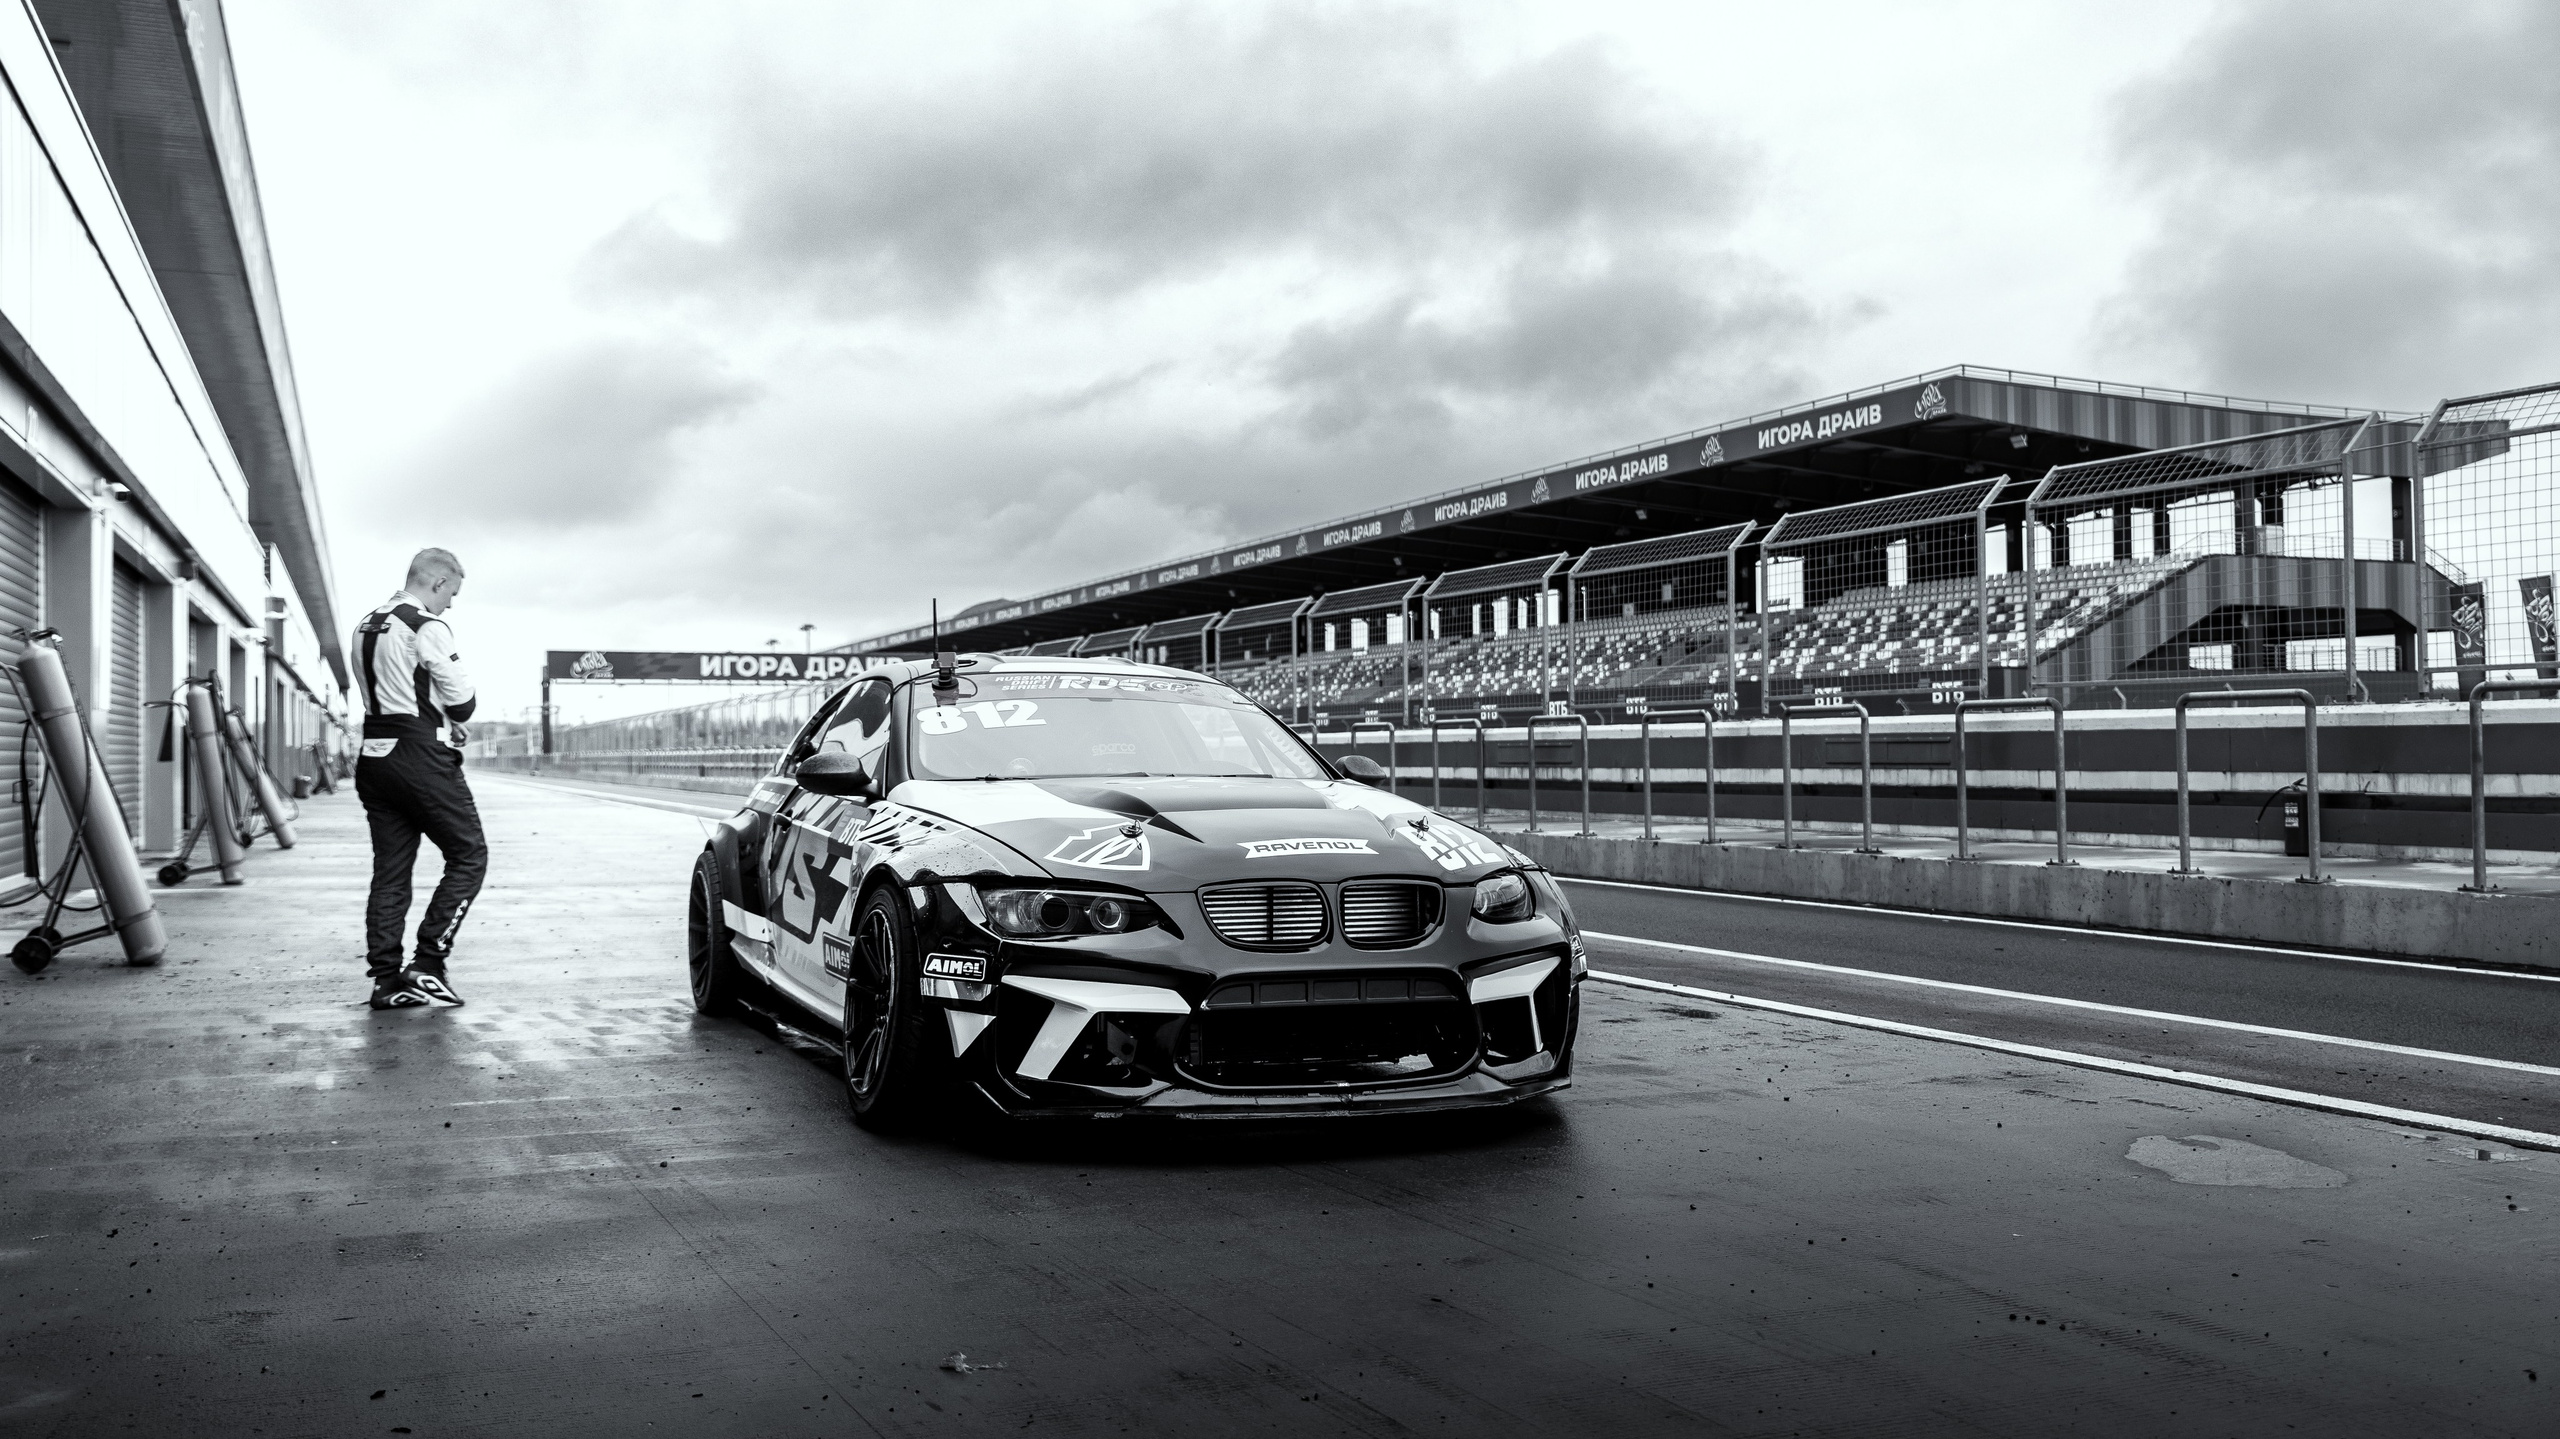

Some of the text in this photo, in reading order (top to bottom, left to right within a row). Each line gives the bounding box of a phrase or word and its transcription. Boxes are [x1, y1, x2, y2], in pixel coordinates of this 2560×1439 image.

[1758, 404, 1882, 450] ИГОРА ДРАЙВ
[1575, 466, 1617, 490] ИГОРА
[1619, 453, 1669, 483] ДРАЙВ
[1434, 501, 1468, 522] ИГОРА
[1469, 491, 1508, 516] ДРАЙВ
[1323, 529, 1350, 547] ИГОРА
[700, 656, 800, 678] ИГОРА
[1058, 676, 1150, 691] RDS
[916, 700, 1047, 735] 812
[1548, 700, 1568, 716] ВТБ
[1253, 841, 1364, 853] RAVENOL
[1395, 824, 1504, 871] 812
[926, 958, 983, 976] AIMOL
